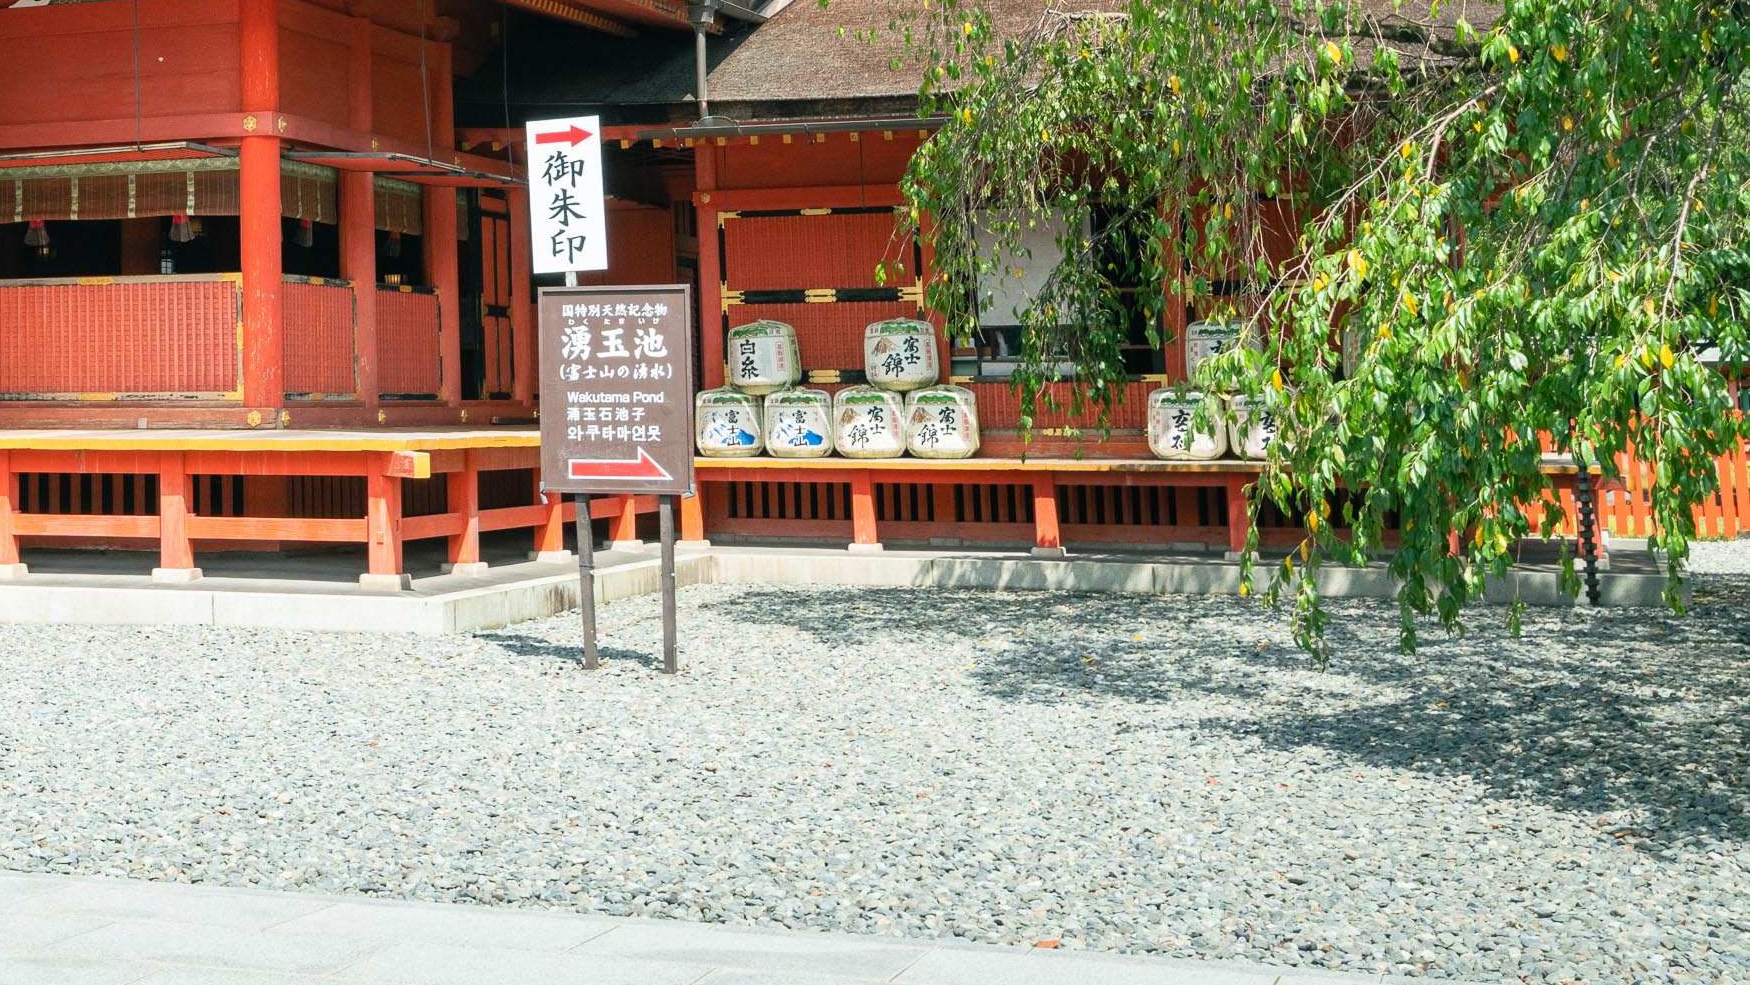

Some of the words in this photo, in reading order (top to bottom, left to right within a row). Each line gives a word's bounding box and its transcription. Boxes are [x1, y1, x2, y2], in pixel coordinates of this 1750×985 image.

[541, 151, 587, 264] 御朱印
[562, 303, 668, 317] 国特別天然記念物
[561, 325, 668, 361] 湧玉池
[740, 338, 760, 380] 白糸
[567, 391, 630, 404] Wakutama
[633, 391, 665, 404] Pond
[725, 409, 741, 447] 富士山
[792, 409, 808, 447] 富士山
